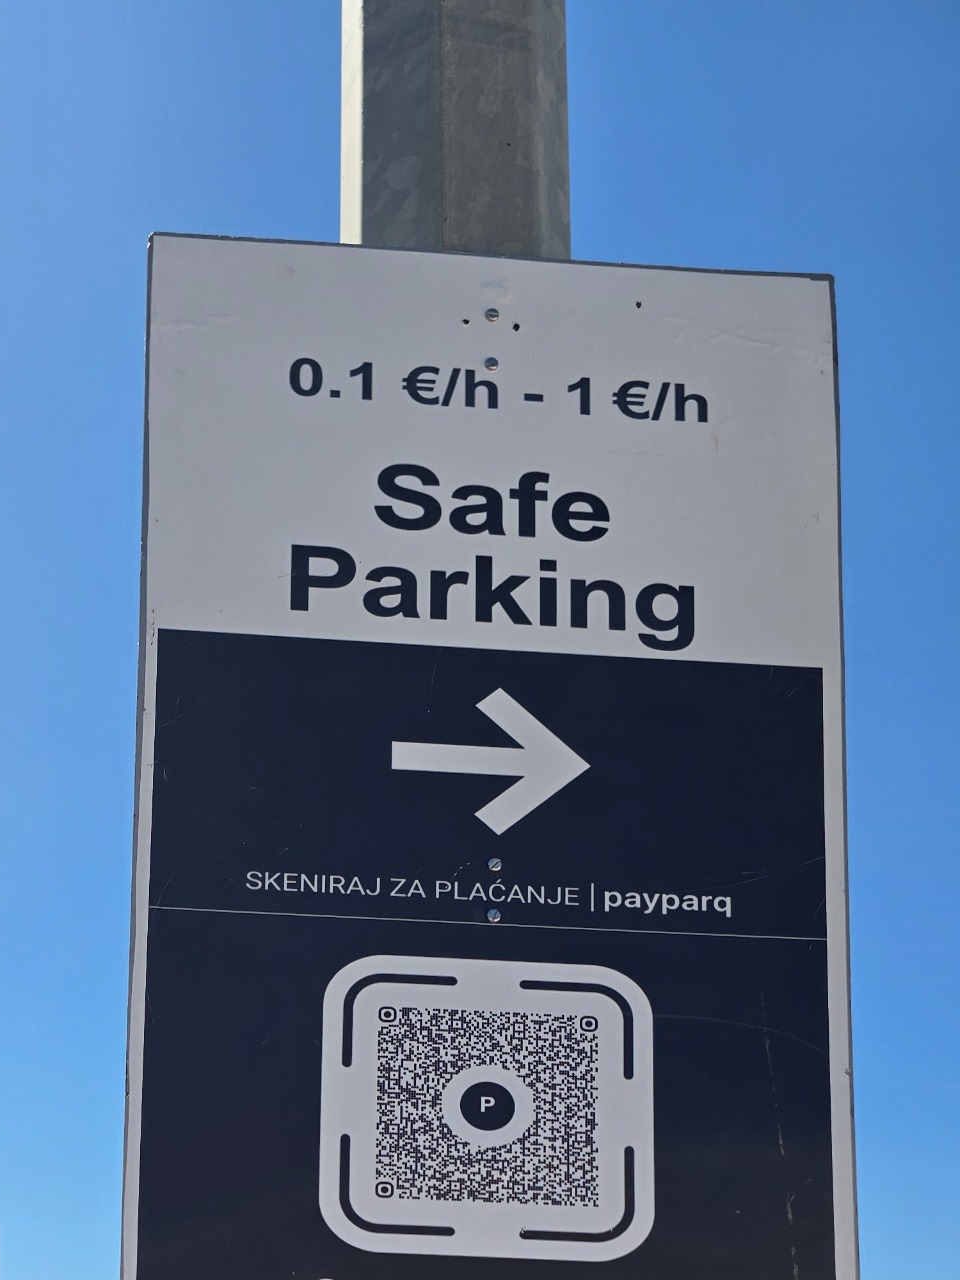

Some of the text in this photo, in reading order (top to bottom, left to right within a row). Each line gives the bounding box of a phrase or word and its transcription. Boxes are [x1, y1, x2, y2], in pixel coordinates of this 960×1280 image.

[289, 358, 708, 423] 0.1 €/h - 1 €/h
[375, 463, 610, 542] Safe
[289, 545, 696, 651] Parking
[245, 870, 381, 896] SKENIRAJ
[390, 878, 425, 898] ZA
[435, 879, 579, 906] PLAĆANJE
[604, 890, 733, 917] payparq
[480, 1097, 495, 1112] P
